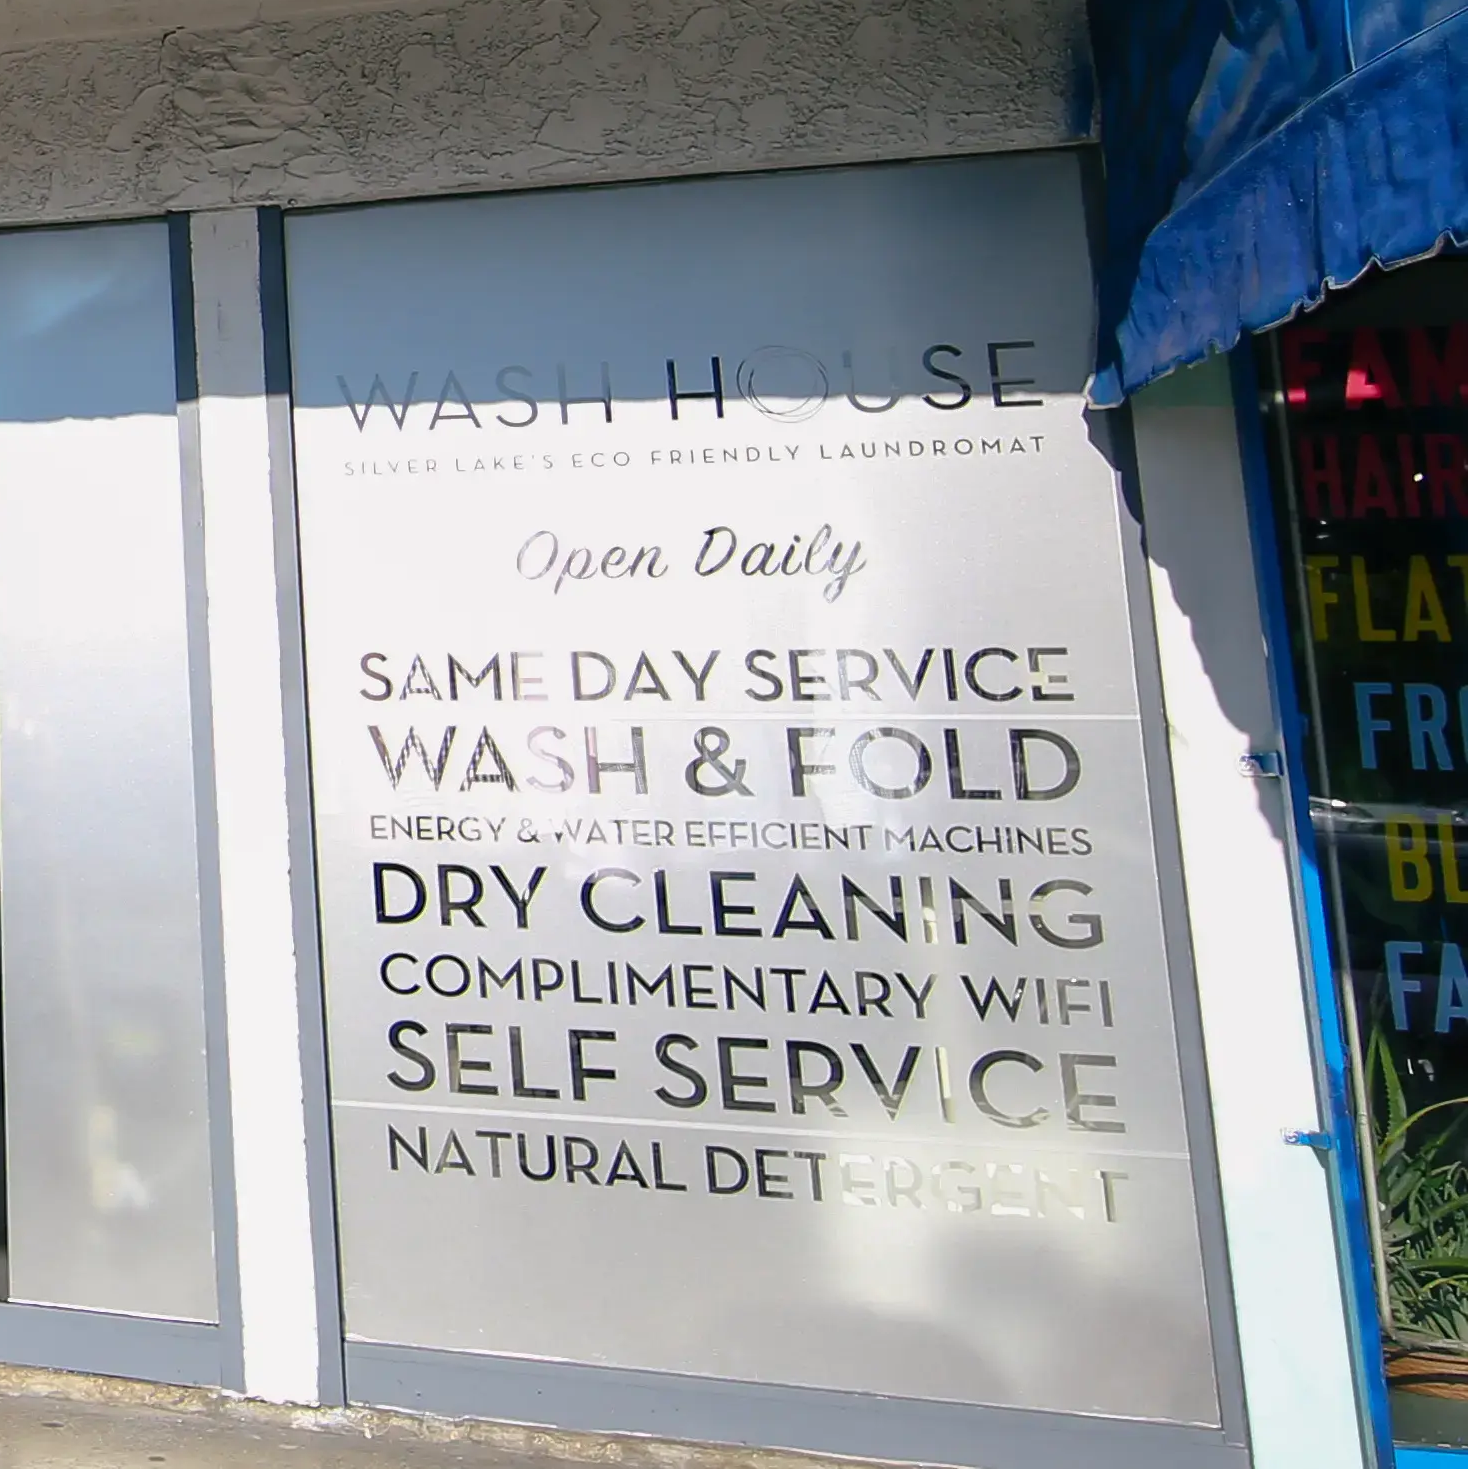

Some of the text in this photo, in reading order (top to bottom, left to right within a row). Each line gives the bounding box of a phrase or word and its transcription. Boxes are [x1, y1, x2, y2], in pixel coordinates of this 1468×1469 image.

[334, 340, 1044, 433] WASH HOUSE
[344, 435, 1045, 476] SILVER LAKE'S ECO FRIENDLY LAUNDROMAT
[516, 523, 867, 604] Open Daily
[359, 647, 1076, 703] SAME DAY SERVICE
[366, 724, 1082, 801] WASH & FOLD
[1352, 681, 1468, 772] FR
[369, 814, 1094, 858] ENERGY & WATER EFFICIENT MACHINES
[372, 862, 1106, 952] DRY CLEANING
[379, 951, 1115, 1029] COMPLIMENTARY WIFI
[385, 1019, 1127, 1134] SELF SERVICE
[388, 1125, 1129, 1224] NATURAL DETERGENT
